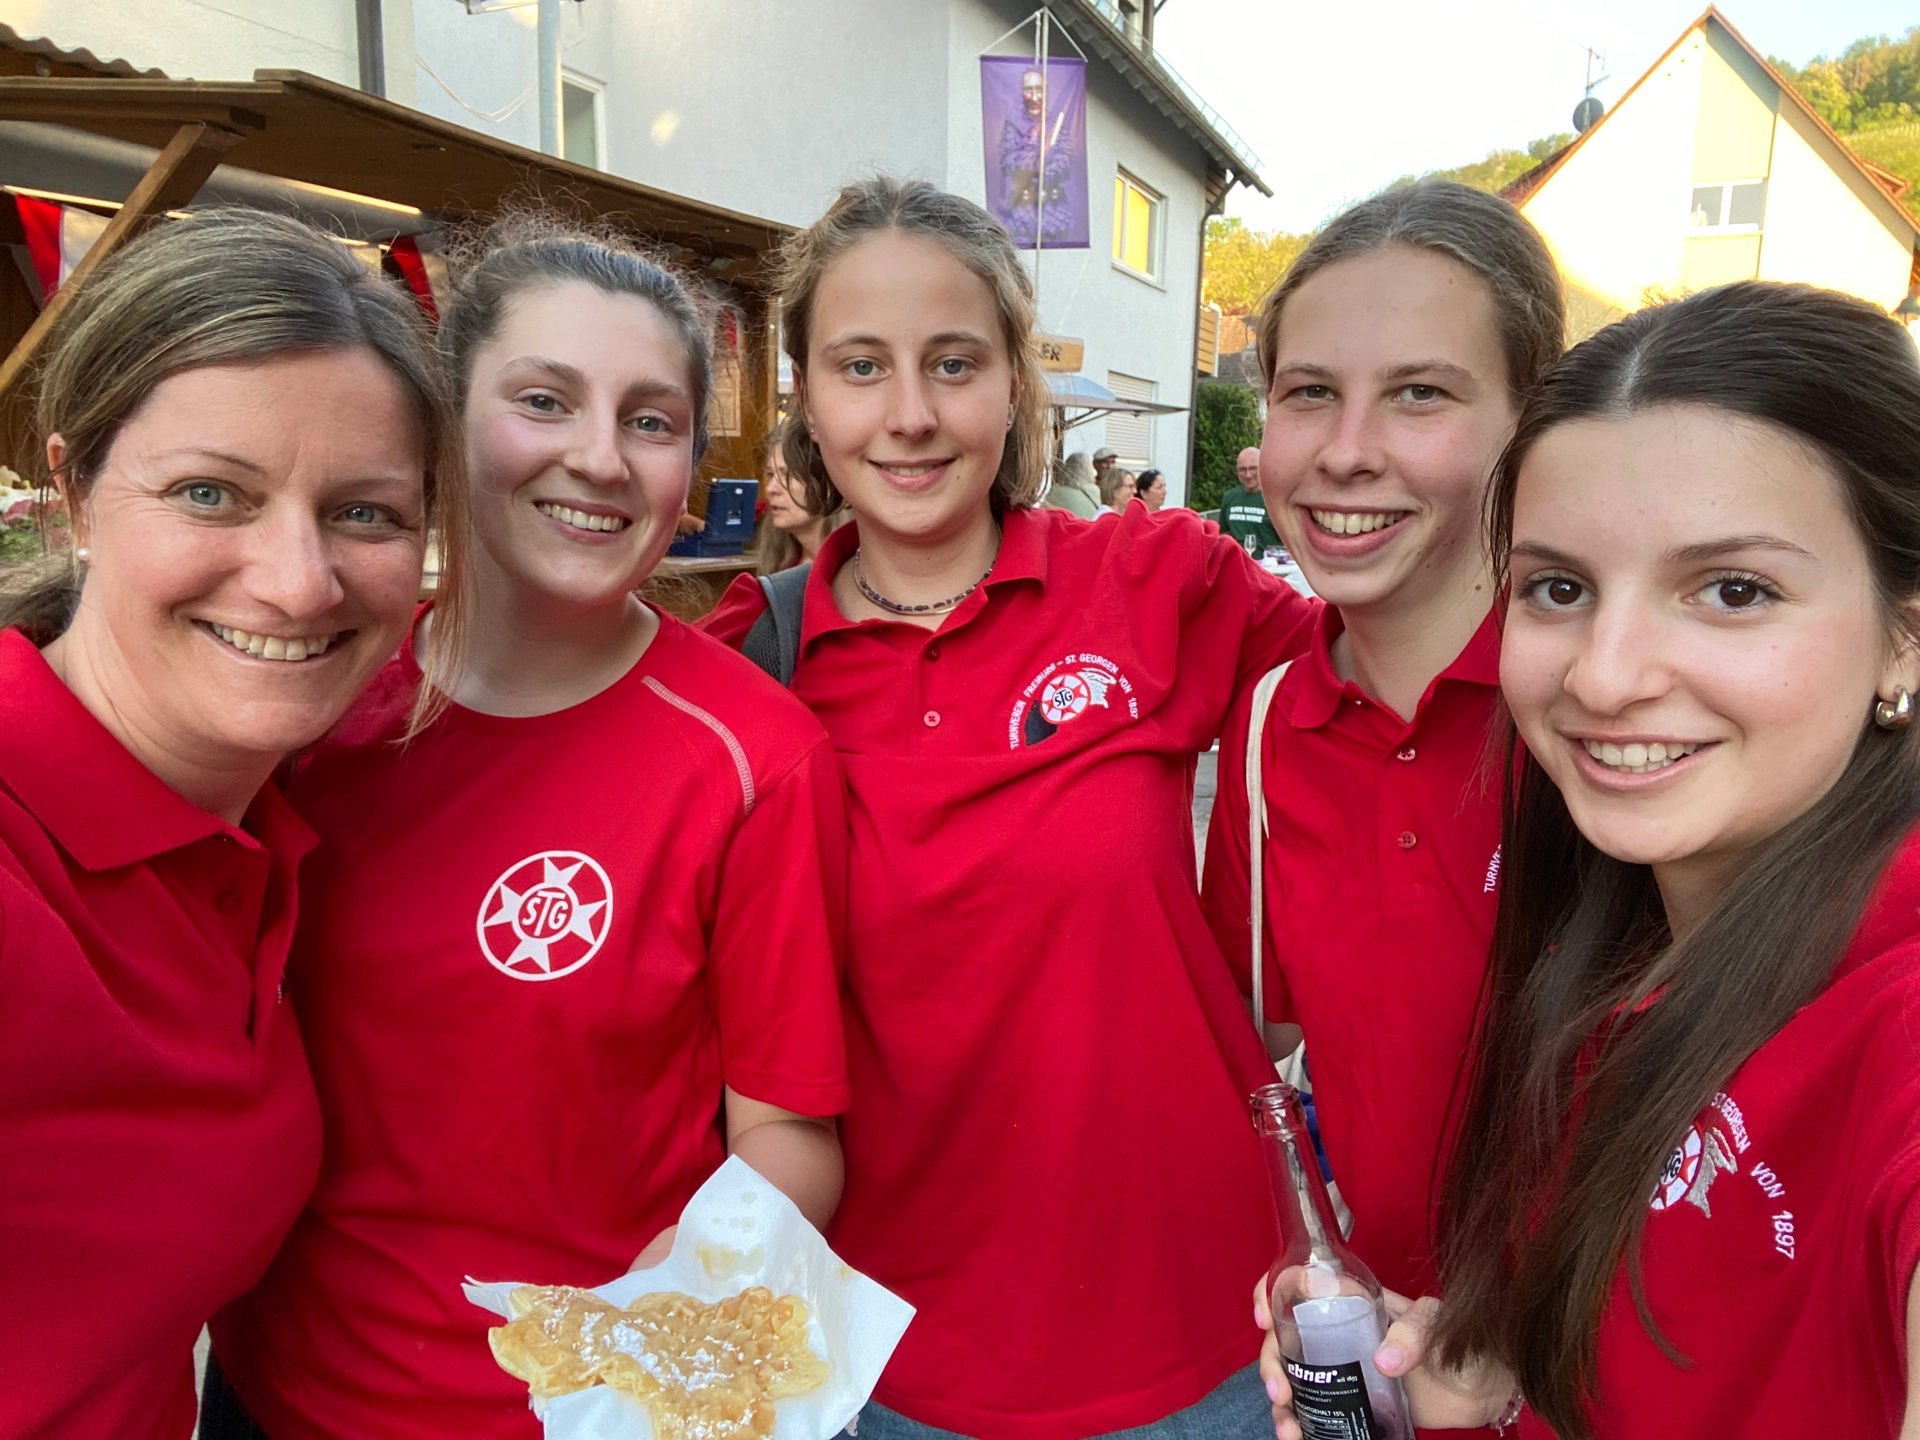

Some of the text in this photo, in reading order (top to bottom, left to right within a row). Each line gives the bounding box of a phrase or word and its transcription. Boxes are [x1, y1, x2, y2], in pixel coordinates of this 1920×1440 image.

[1040, 342, 1062, 361] ER
[1009, 700, 1026, 750] TURNVEREIN
[1023, 663, 1056, 698] FREIBURG
[1079, 653, 1119, 674] GEORGEN
[1118, 674, 1133, 694] VON
[1128, 697, 1138, 720] 1897
[1054, 689, 1073, 707] STG
[1483, 844, 1501, 893] TURNVE
[522, 890, 569, 936] STG
[1721, 1097, 1751, 1154] GEORGEN
[1751, 1162, 1785, 1198] VON
[1772, 1210, 1795, 1260] 1897
[1287, 1363, 1338, 1384] ebner
